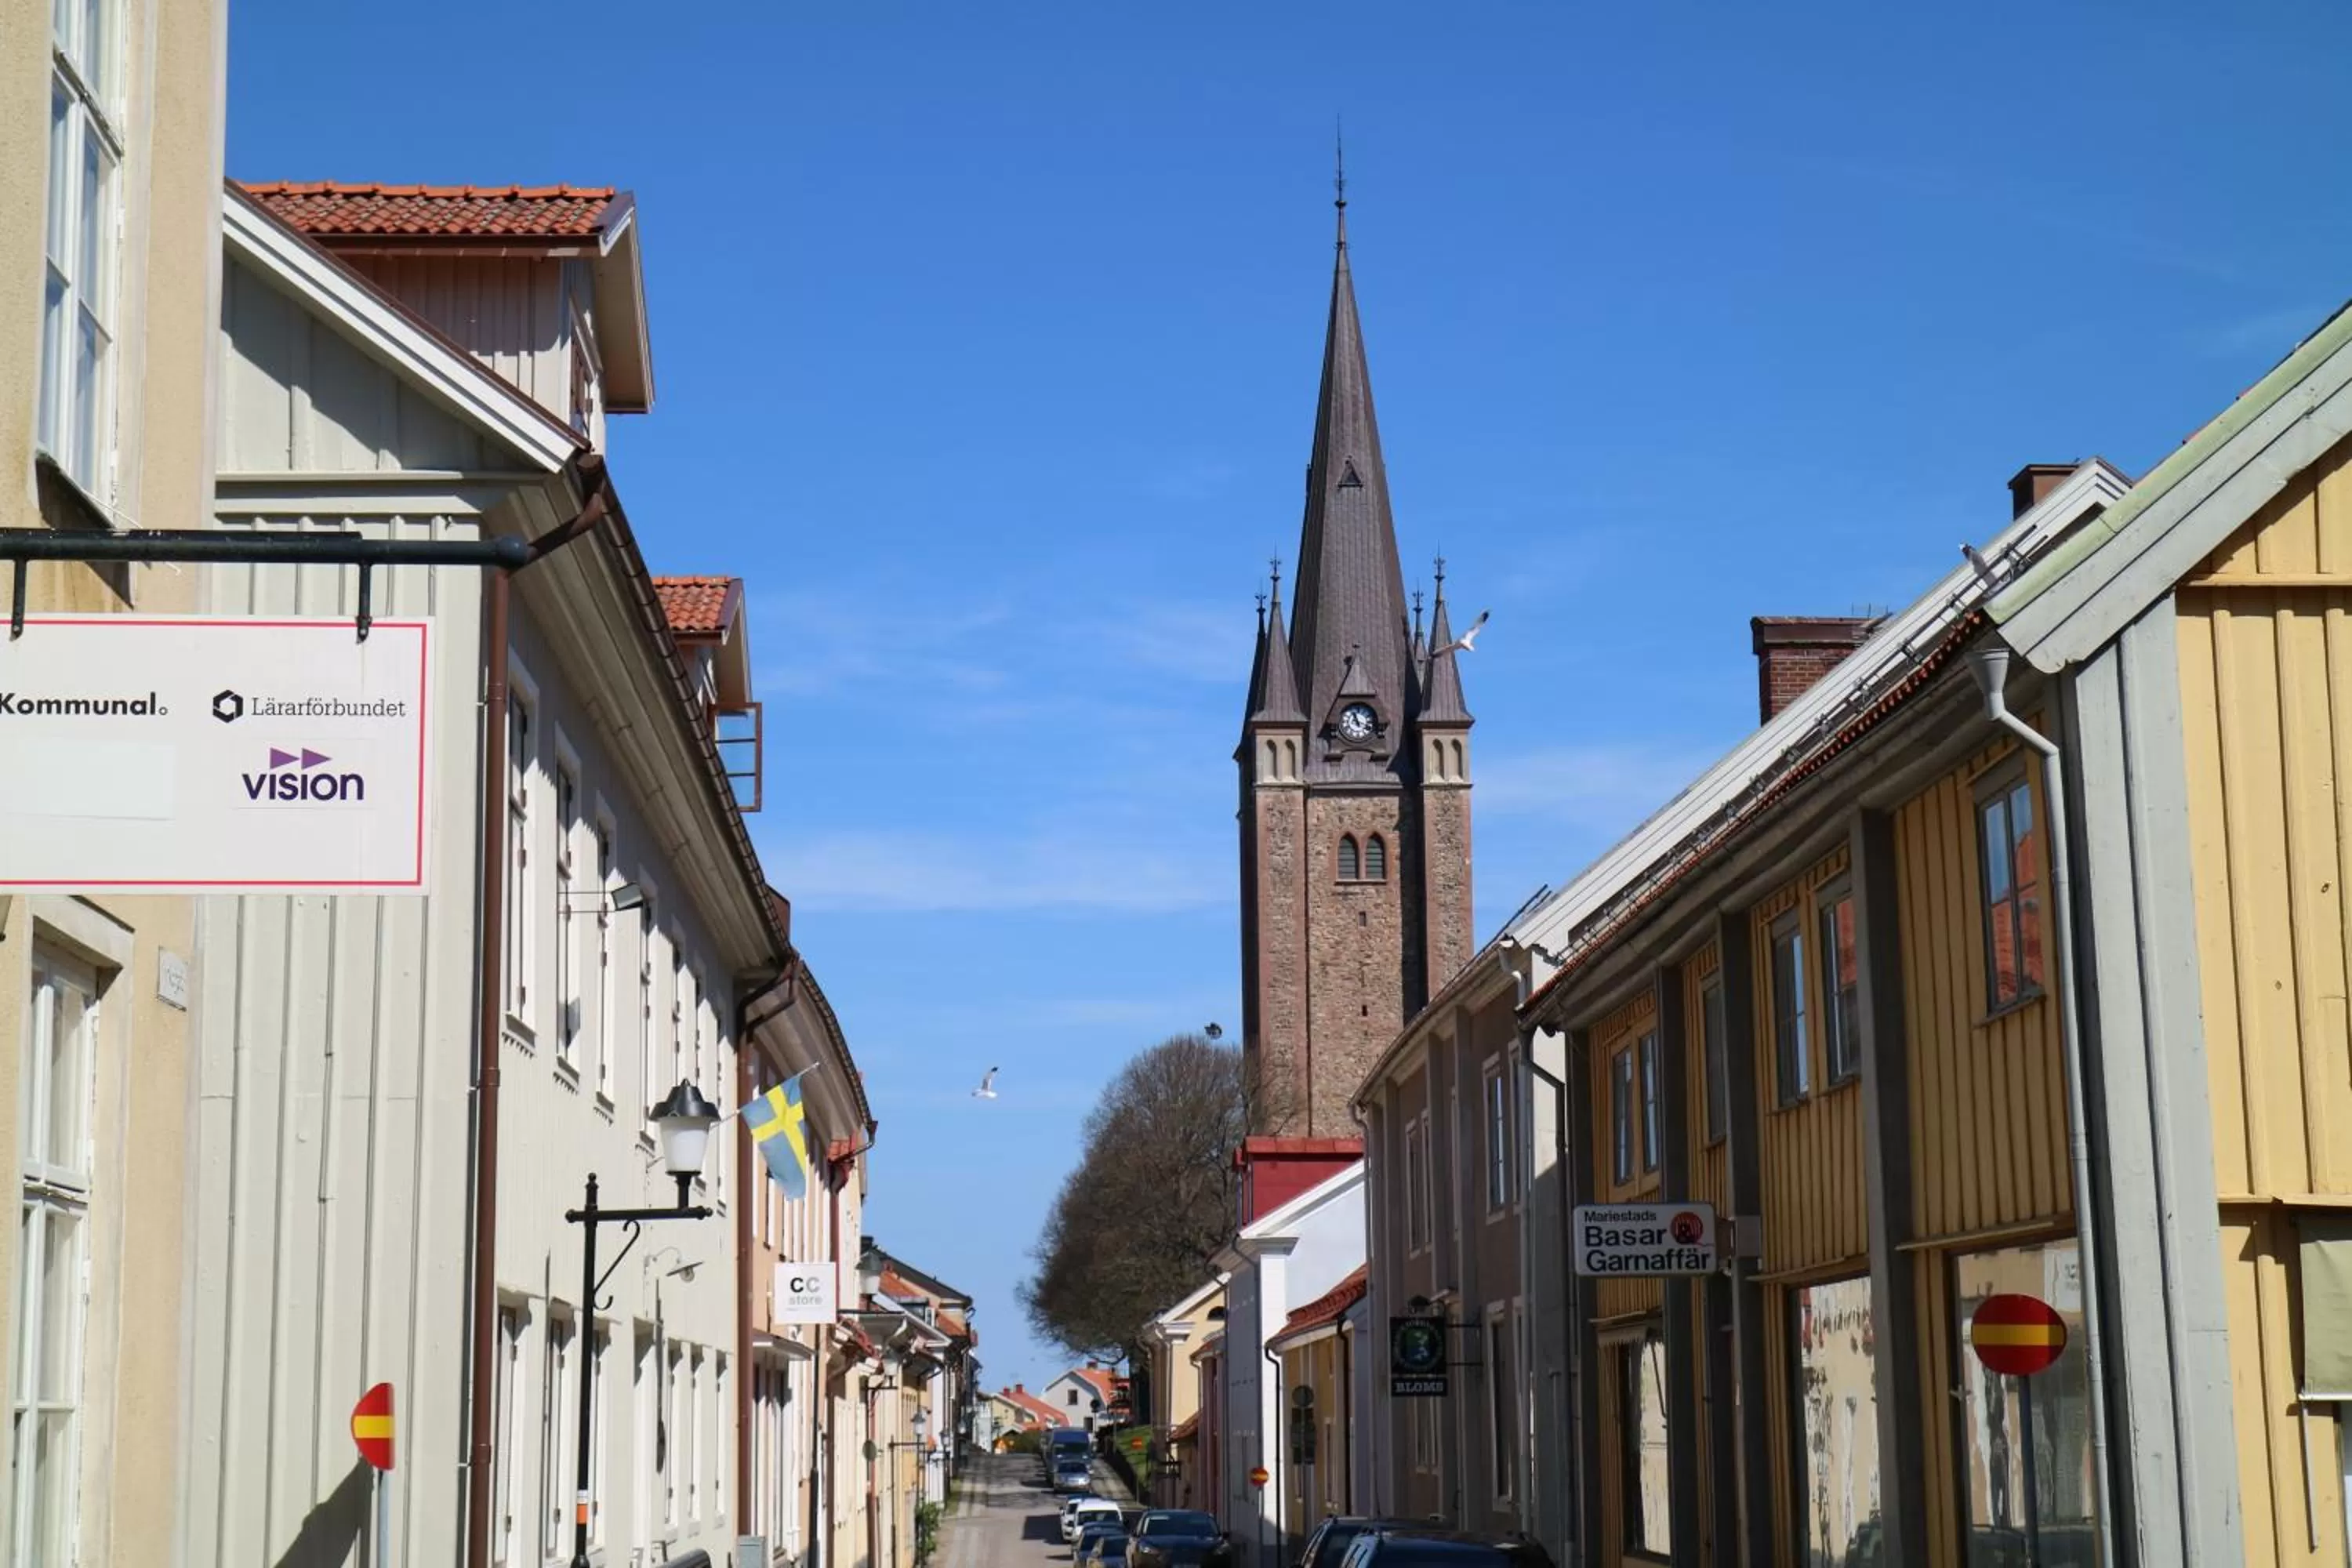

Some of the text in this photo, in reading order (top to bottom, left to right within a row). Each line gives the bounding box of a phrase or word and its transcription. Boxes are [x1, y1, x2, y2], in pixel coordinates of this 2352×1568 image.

[251, 696, 406, 717] Lärarförbundet
[241, 772, 365, 800] vision
[1584, 1210, 1657, 1221] Mariestads
[1585, 1226, 1667, 1247] Basar
[1586, 1249, 1710, 1272] Garnaffär
[789, 1294, 823, 1305] store
